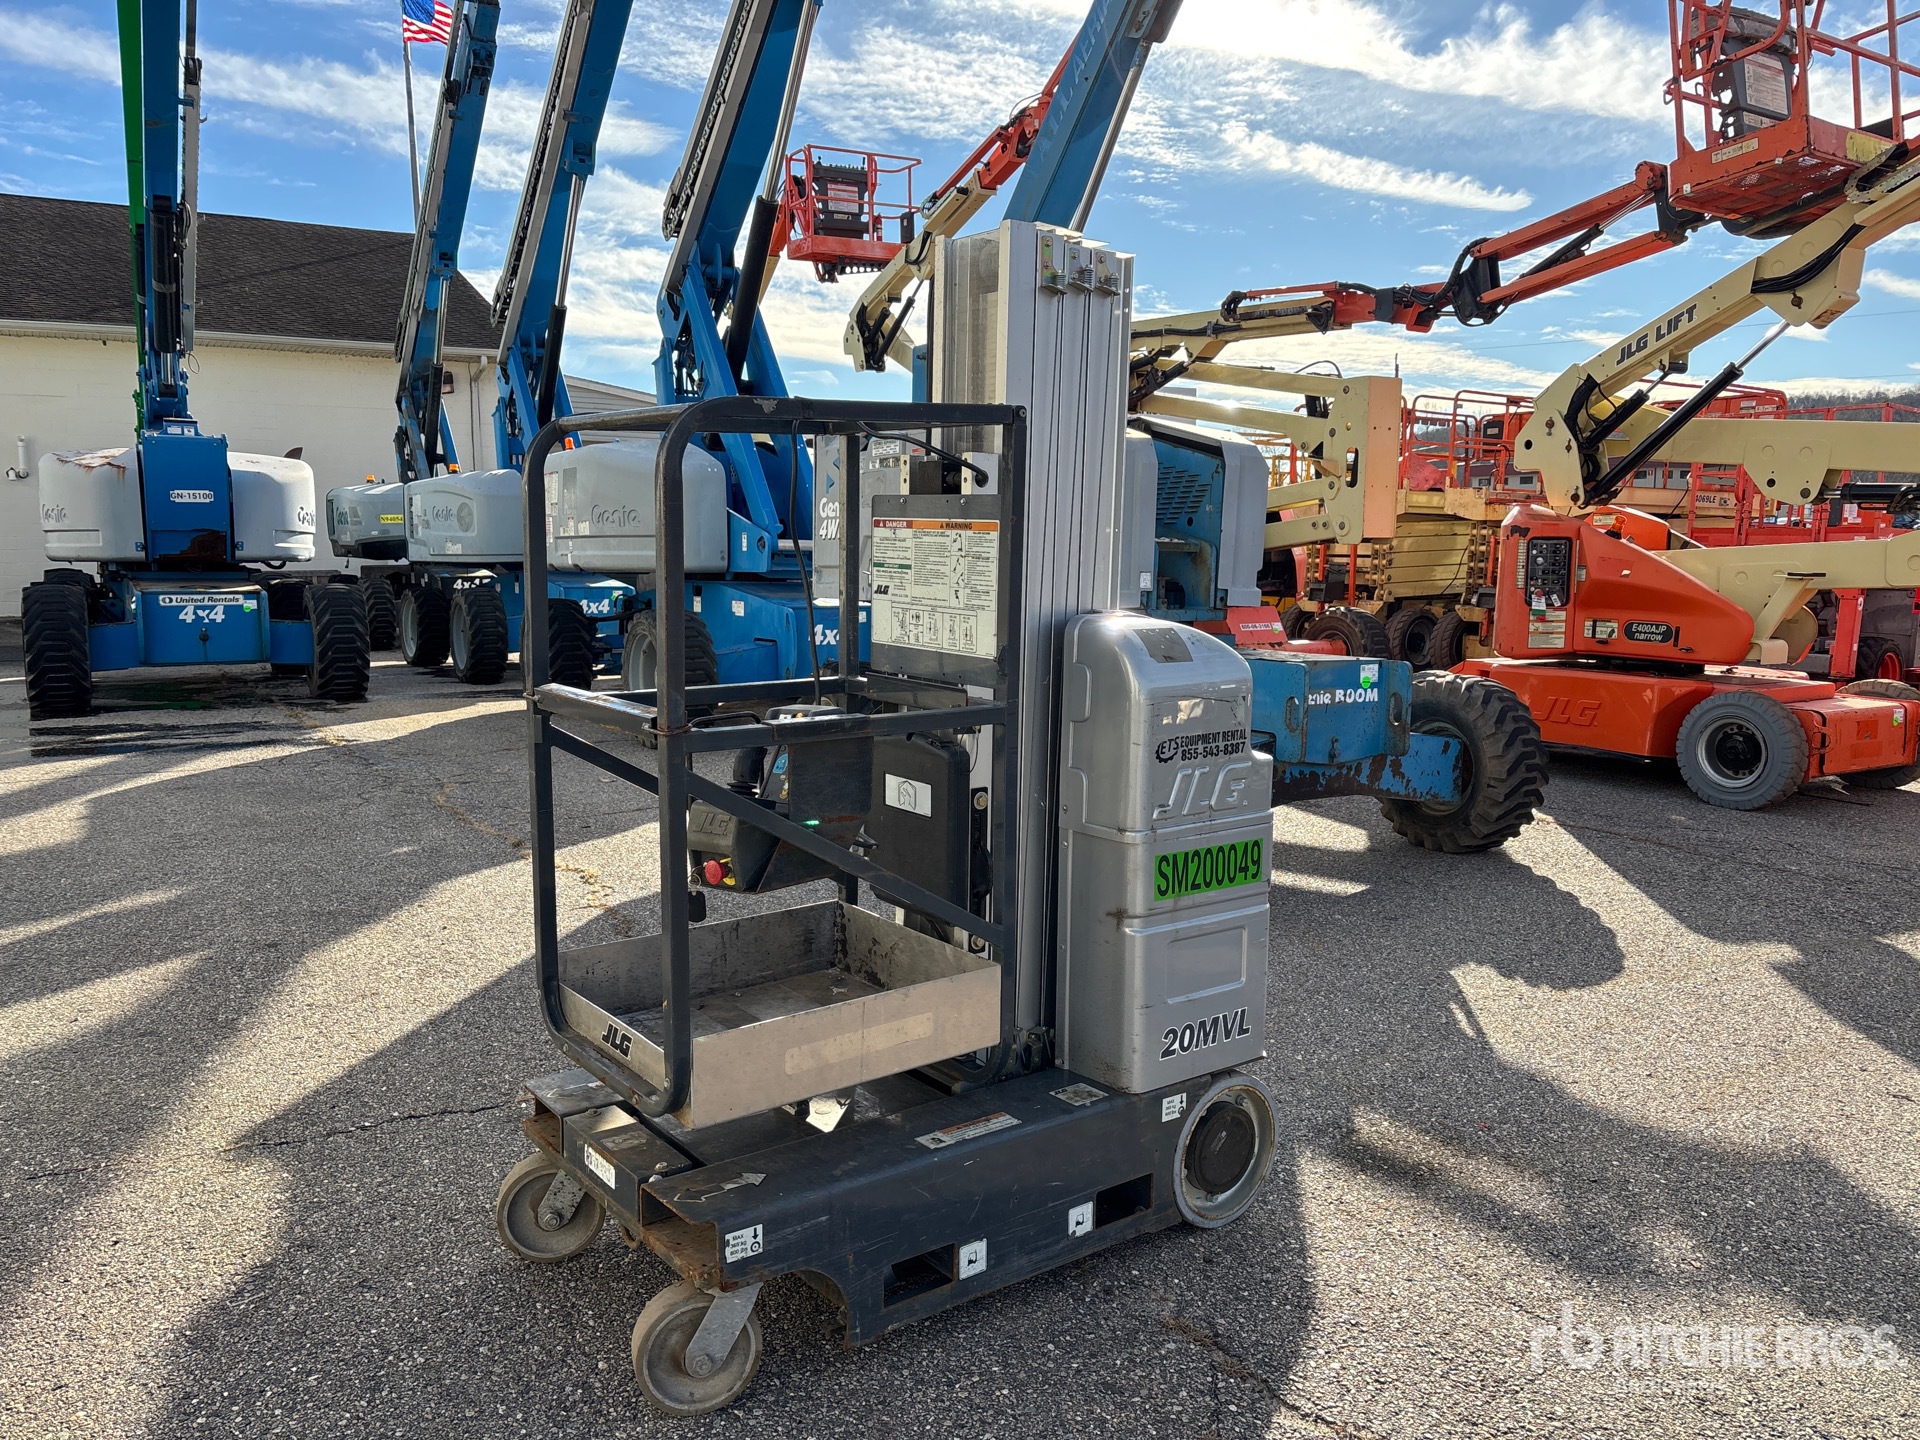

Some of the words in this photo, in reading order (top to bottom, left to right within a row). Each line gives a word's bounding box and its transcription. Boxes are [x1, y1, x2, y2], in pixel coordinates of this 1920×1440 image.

[1615, 332, 1649, 366] JLG
[1655, 303, 1697, 343] LIFT
[170, 492, 213, 500] GN-15100
[591, 504, 642, 528] Genie
[819, 497, 840, 518] Gen
[819, 518, 840, 540] 4W
[885, 520, 907, 528] DANGER
[945, 522, 973, 530] WARNING
[175, 596, 206, 604] United
[874, 584, 890, 596] JLG
[579, 599, 611, 614] 4x4
[809, 624, 840, 646] 4x
[1631, 623, 1667, 633] E400AJP
[1634, 632, 1663, 641] narrow
[1335, 688, 1378, 703] BOOM
[1533, 696, 1603, 727] JLG
[1160, 737, 1180, 755] ETS
[1180, 731, 1222, 748] EQUIPMENT
[1222, 728, 1248, 743] RENTAL
[1181, 741, 1246, 762] 855-543-8387
[1153, 761, 1252, 820] JLG
[1156, 839, 1262, 897] SM200049
[601, 1021, 633, 1059] JLG
[1158, 1007, 1252, 1061] 20MVL
